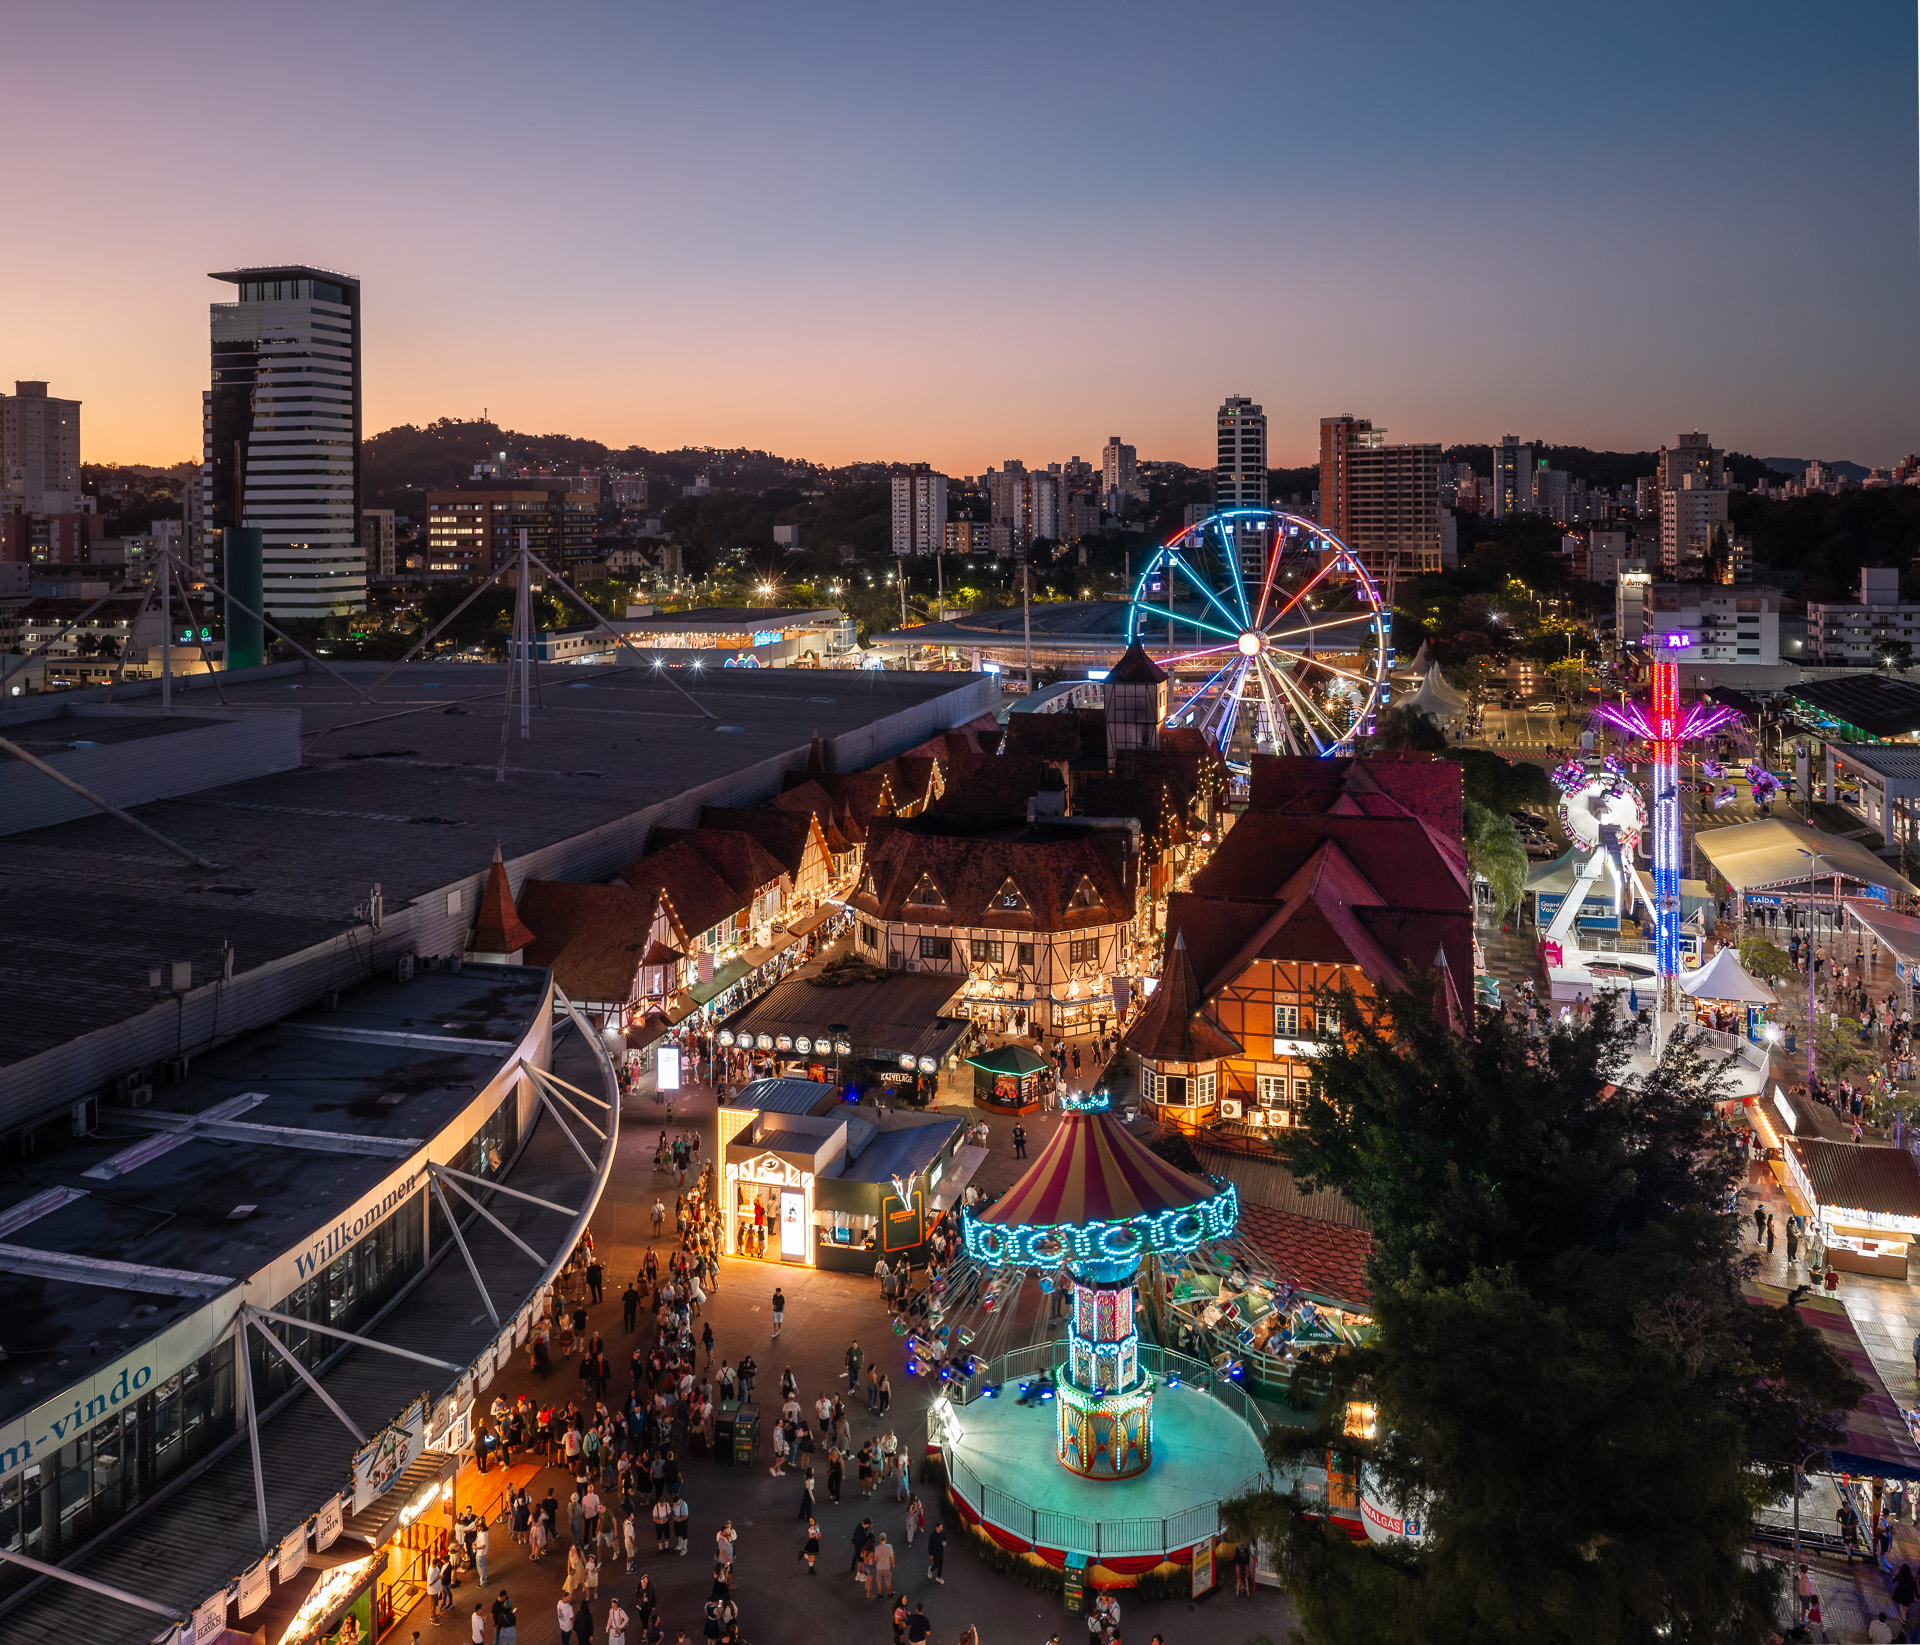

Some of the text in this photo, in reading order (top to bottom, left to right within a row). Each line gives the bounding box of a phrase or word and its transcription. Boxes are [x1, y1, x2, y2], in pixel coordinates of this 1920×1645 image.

[1541, 906, 1558, 914] Volu
[1752, 896, 1775, 904] SAÍDA
[294, 1174, 416, 1280] Willkommen
[1361, 1499, 1401, 1531] ONALGÁS
[320, 1518, 339, 1539] SPATEN
[198, 1615, 221, 1638] HAVAN
